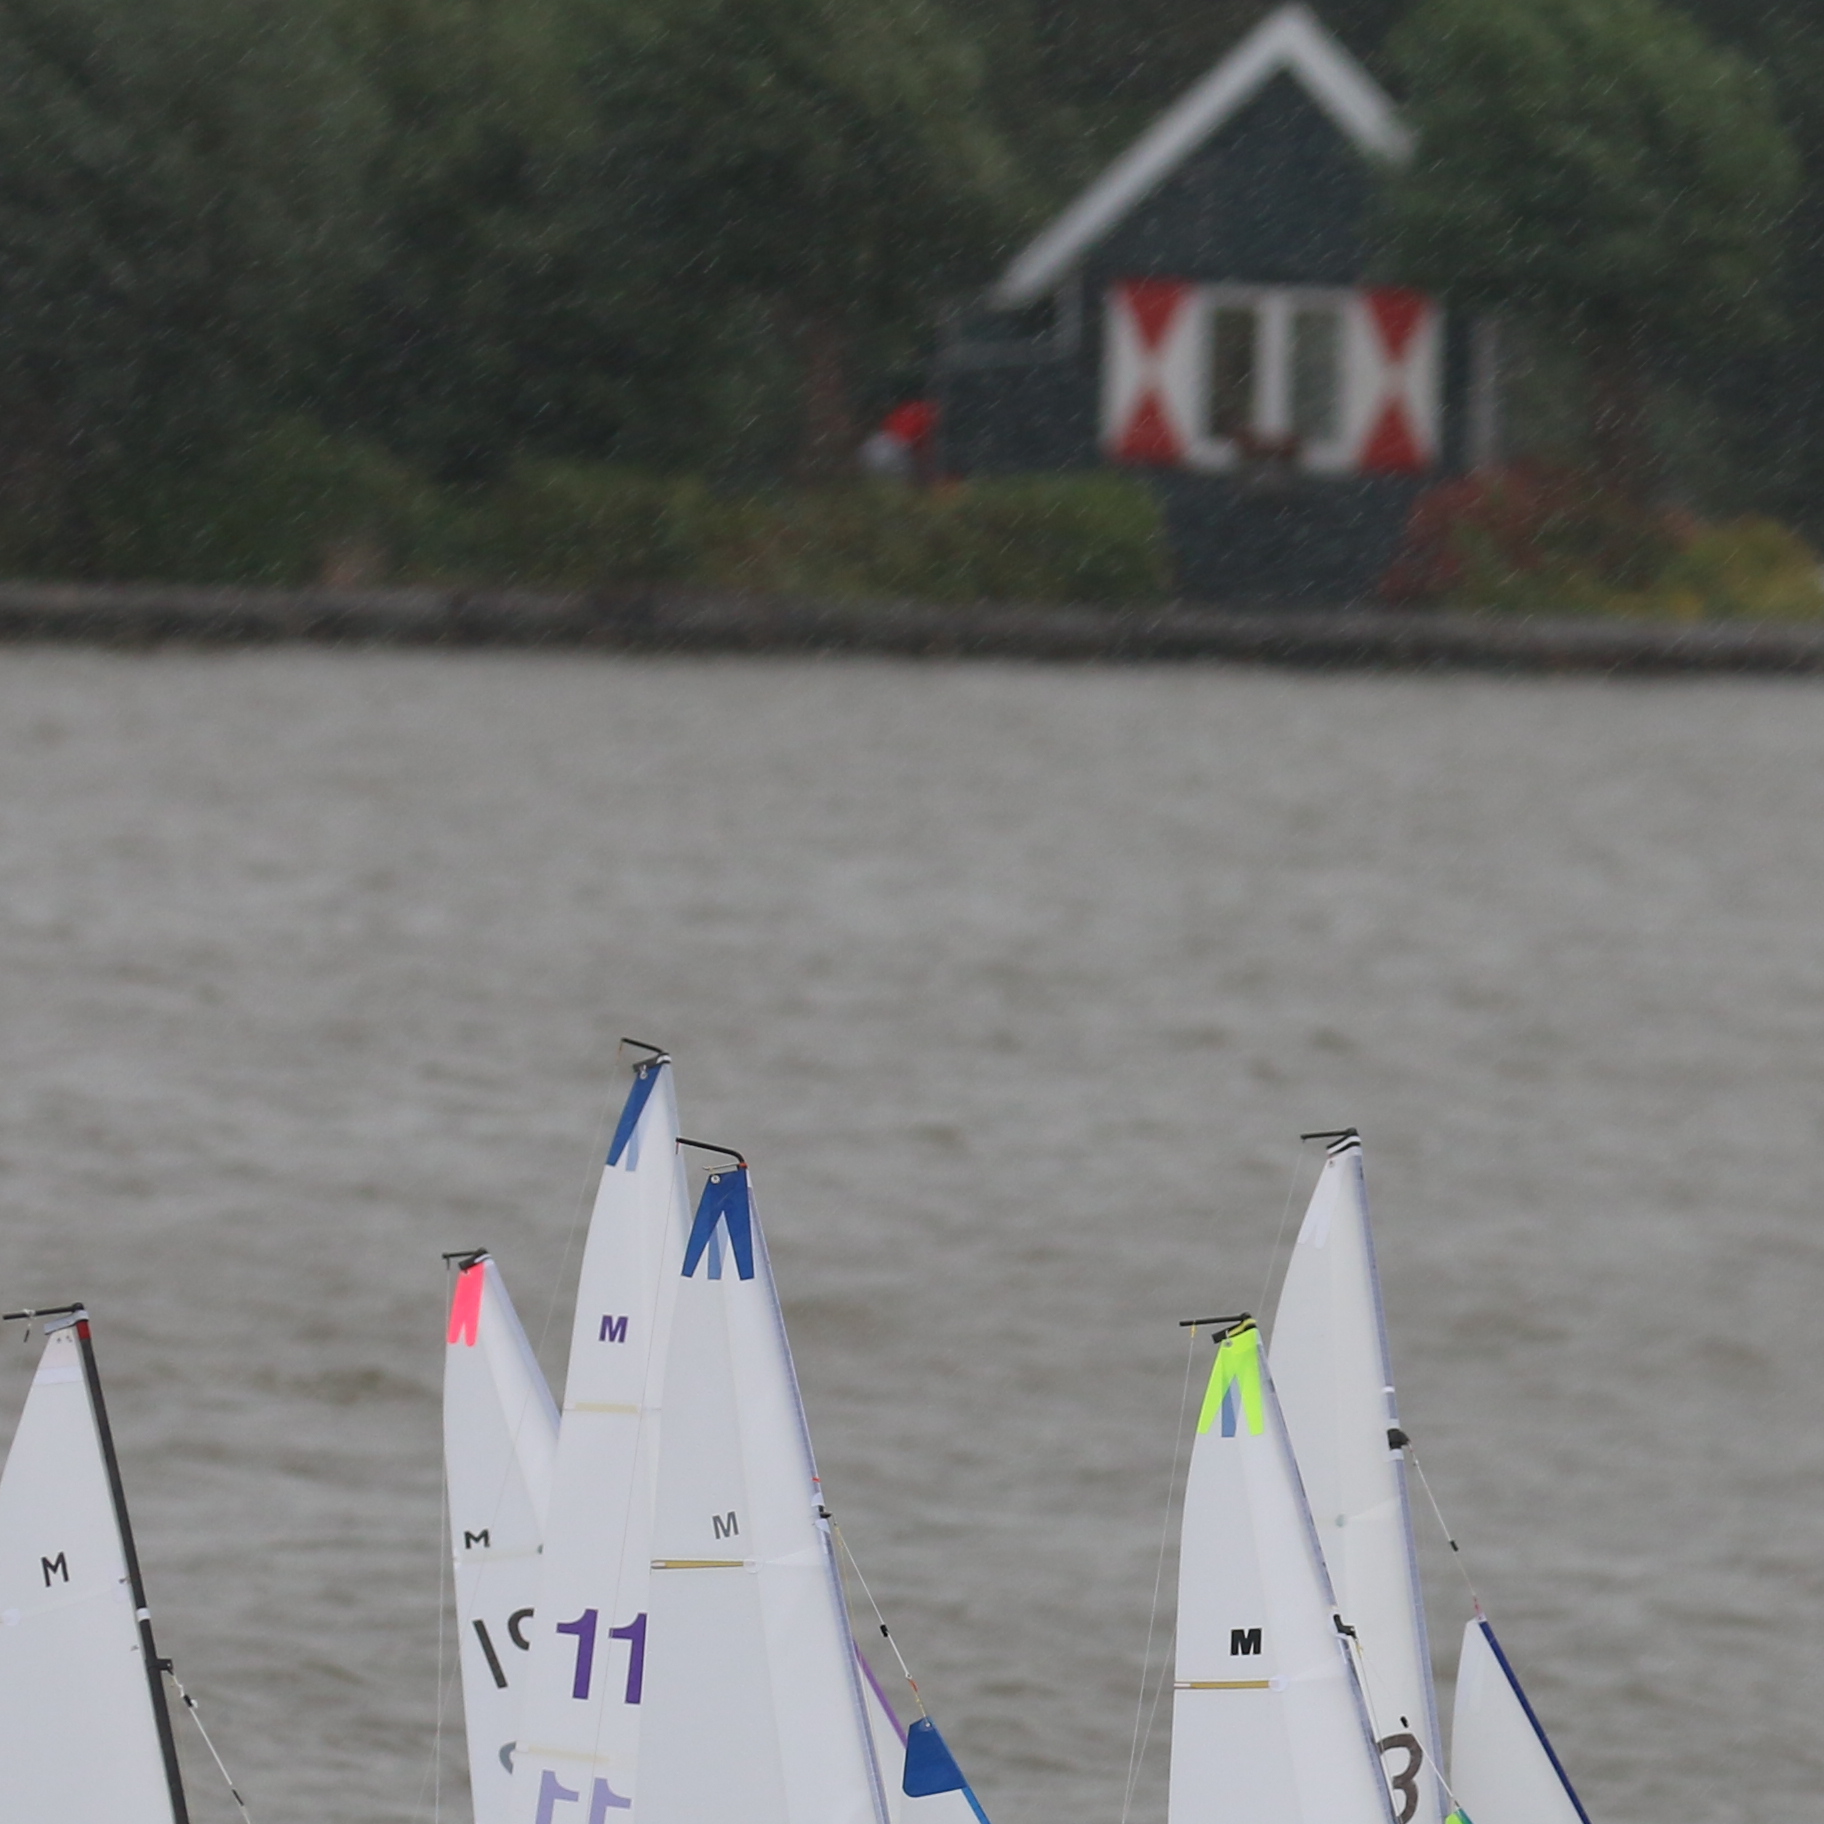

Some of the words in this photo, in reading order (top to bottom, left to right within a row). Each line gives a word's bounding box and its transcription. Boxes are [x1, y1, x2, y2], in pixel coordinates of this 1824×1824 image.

[600, 1316, 628, 1342] M
[713, 1512, 738, 1539] M
[465, 1530, 489, 1549] M
[42, 1552, 68, 1587] M
[1231, 1629, 1261, 1655] M
[557, 1609, 647, 1704] 11
